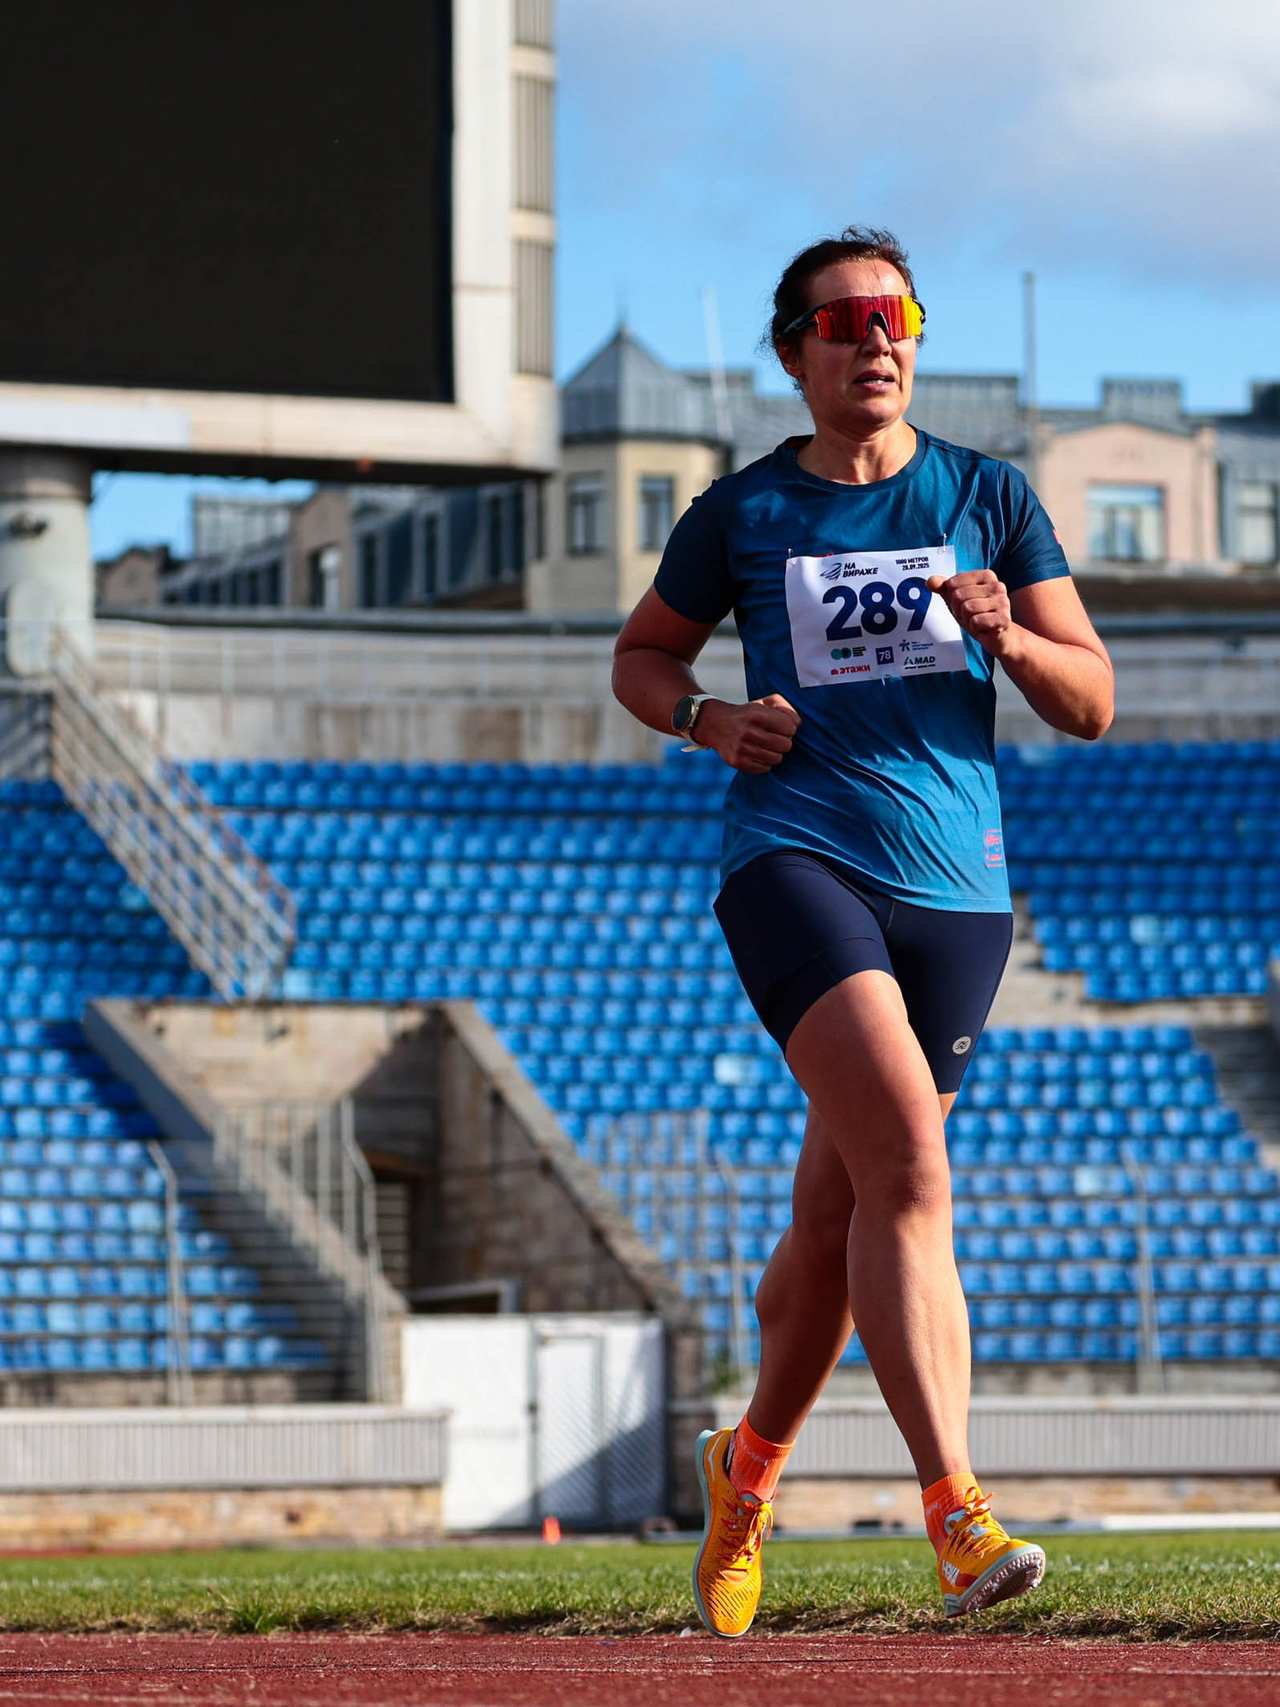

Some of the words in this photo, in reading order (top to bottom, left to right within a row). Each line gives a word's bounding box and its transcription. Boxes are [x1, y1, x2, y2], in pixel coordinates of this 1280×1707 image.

[908, 556, 929, 564] МЕТРОВ
[844, 562, 856, 570] НА
[842, 567, 879, 578] ВИРАЖЕ
[822, 576, 933, 641] 289
[878, 650, 892, 662] 78
